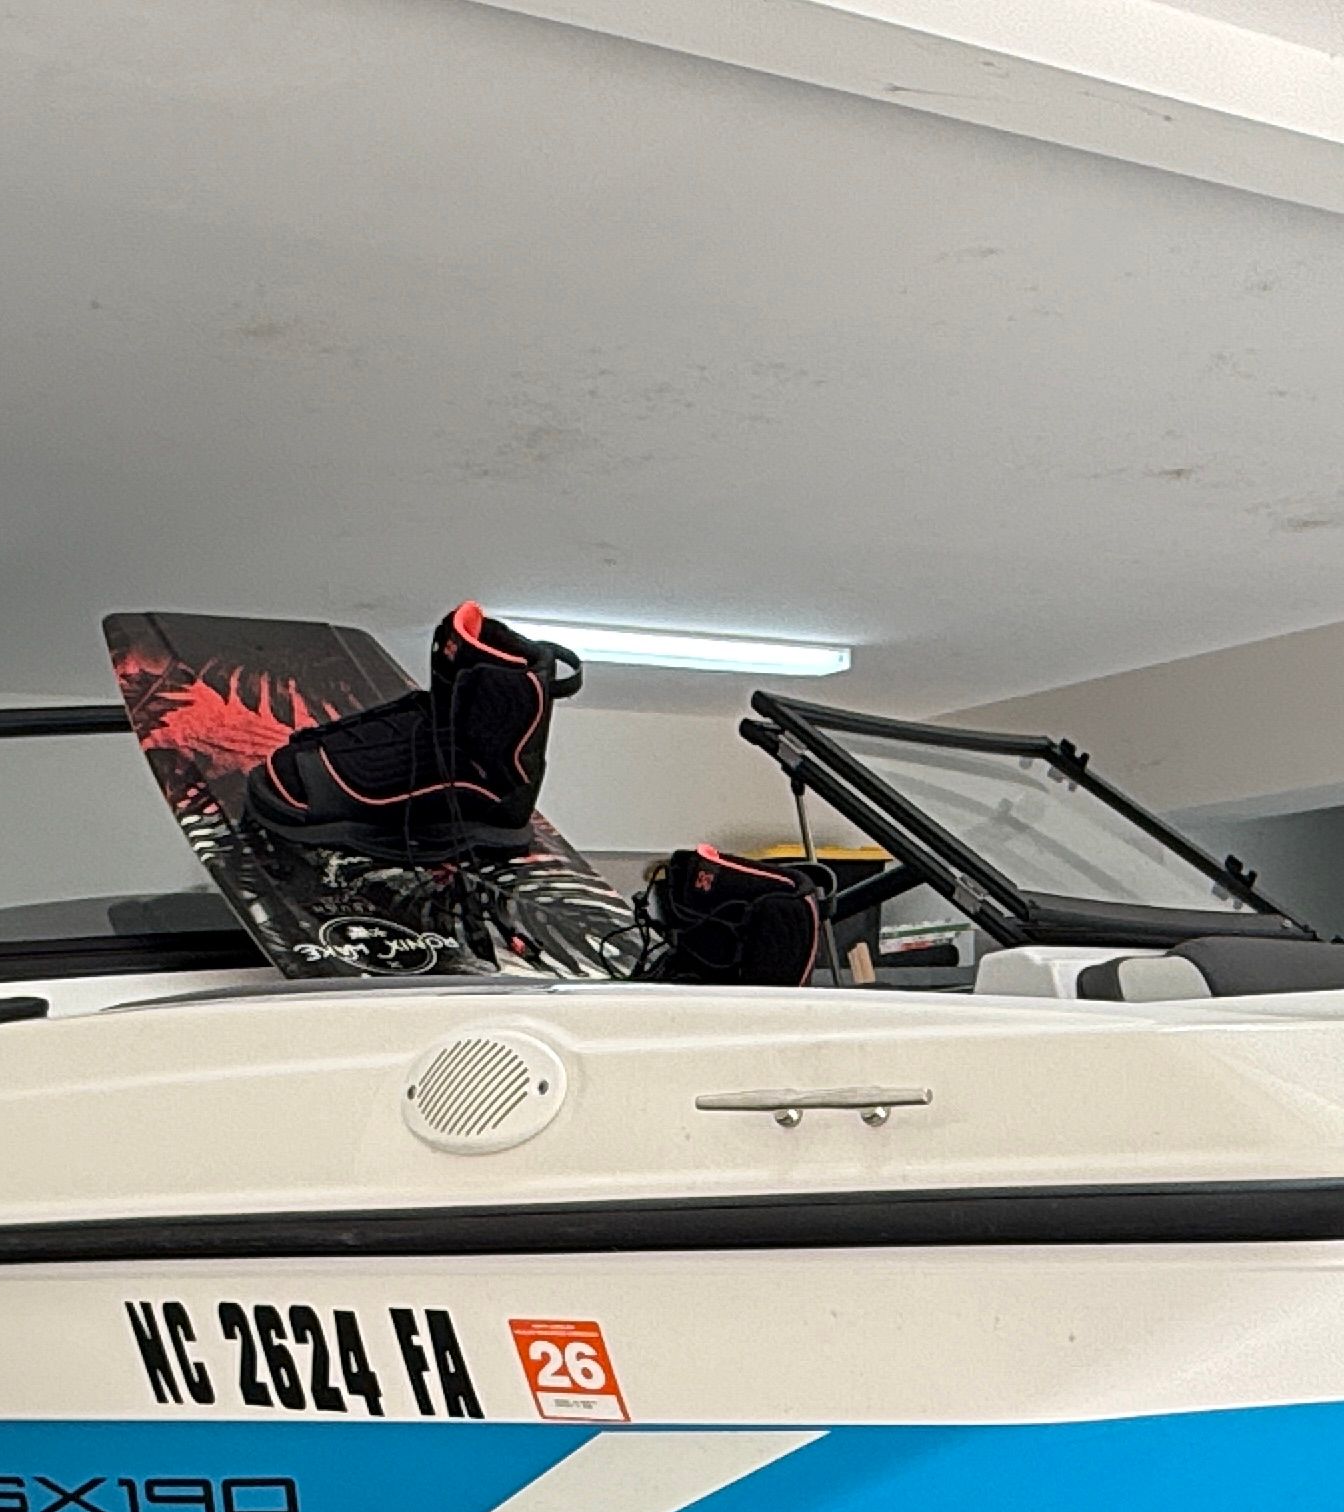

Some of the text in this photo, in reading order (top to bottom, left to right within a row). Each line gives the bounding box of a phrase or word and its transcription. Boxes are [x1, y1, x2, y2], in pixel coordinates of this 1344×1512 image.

[124, 1301, 486, 1420] NC 2624 FA
[528, 1340, 606, 1391] 26
